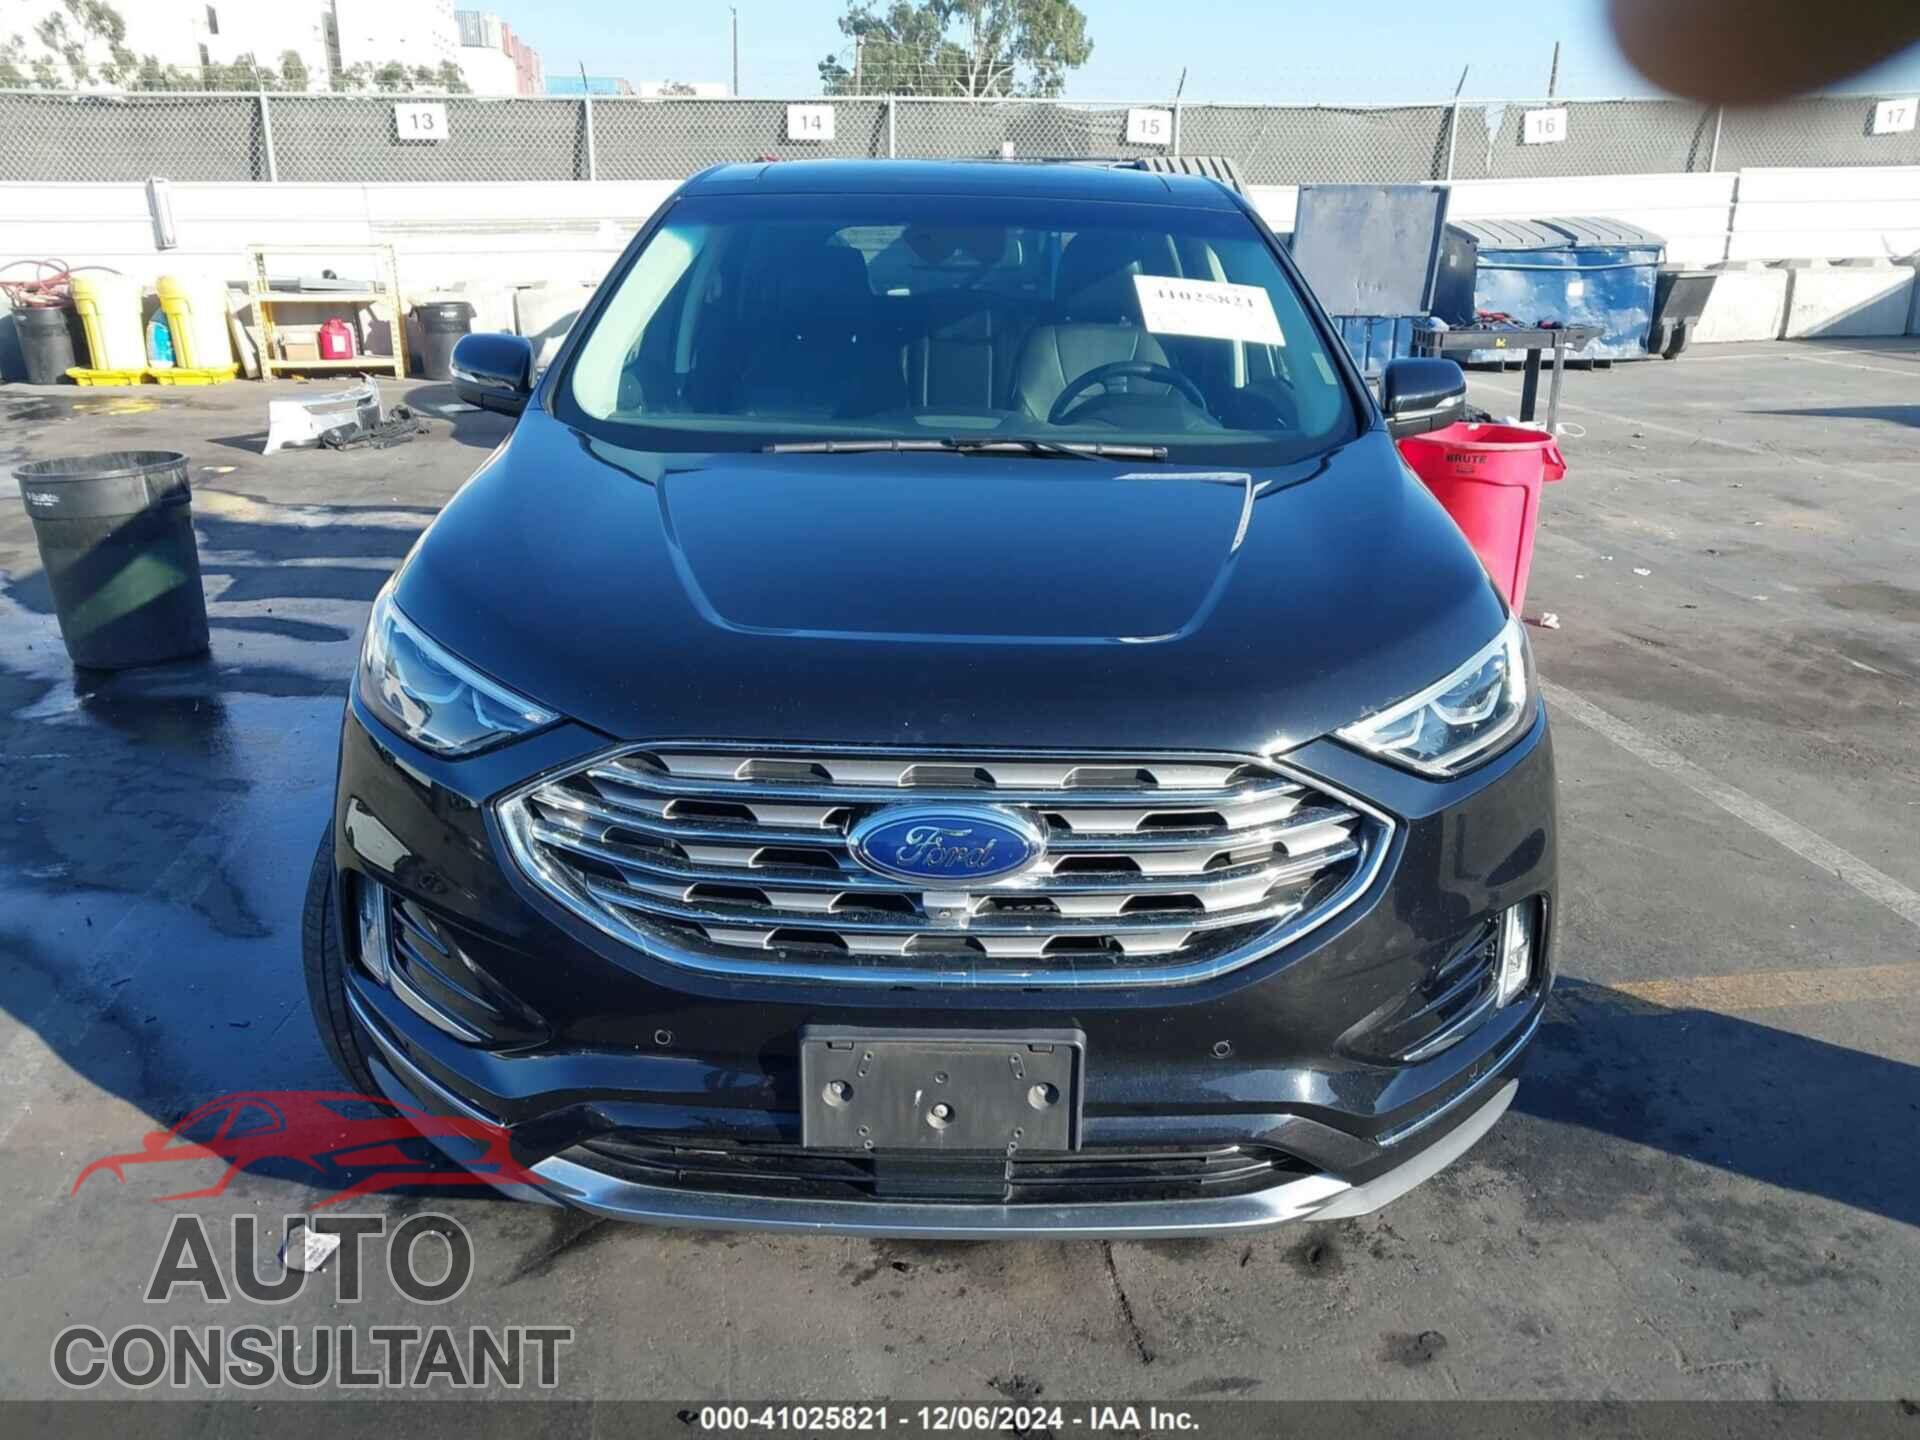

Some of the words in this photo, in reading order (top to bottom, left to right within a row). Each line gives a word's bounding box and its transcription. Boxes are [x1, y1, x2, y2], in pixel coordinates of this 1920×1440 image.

[409, 112, 435, 131] 13
[800, 114, 822, 131] 14
[1886, 107, 1906, 125] 17
[1138, 118, 1160, 135] 15
[1534, 117, 1556, 134] 16
[1446, 453, 1488, 464] BRUTE
[896, 825, 998, 868] Ford
